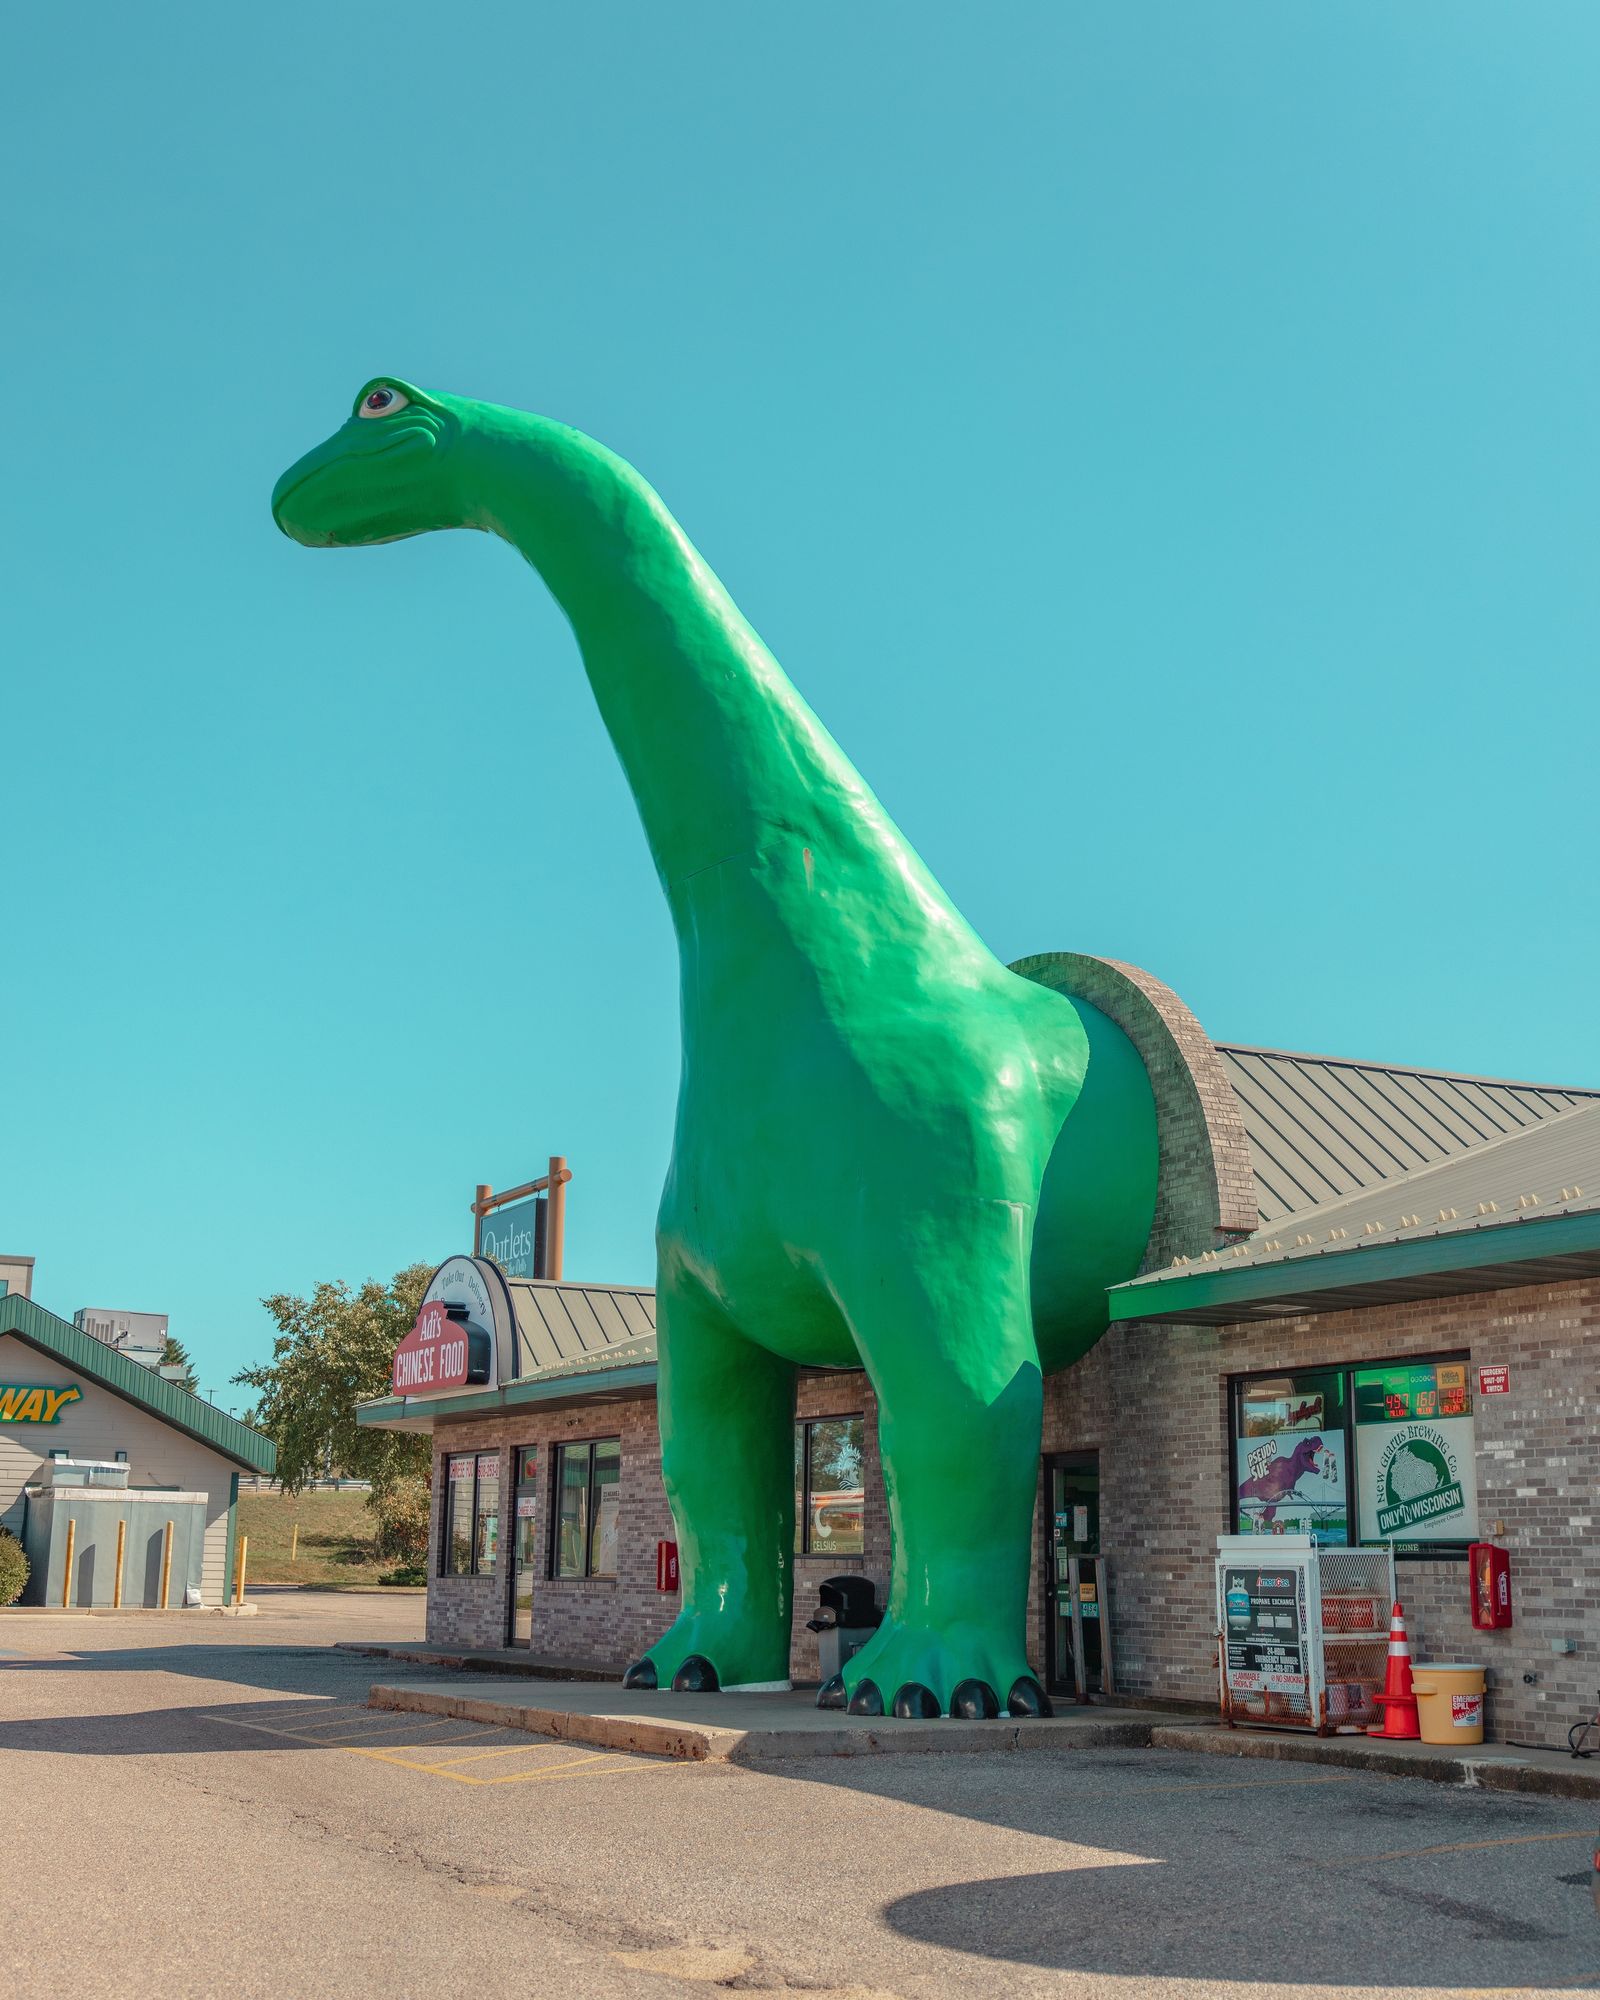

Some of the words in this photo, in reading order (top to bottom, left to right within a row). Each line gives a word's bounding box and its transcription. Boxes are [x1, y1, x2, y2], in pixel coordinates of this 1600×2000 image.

[484, 1222, 531, 1262] Outlets
[441, 1272, 454, 1290] Take
[455, 1270, 465, 1283] Out
[468, 1276, 487, 1316] Delivery
[420, 1309, 441, 1341] Adi's
[396, 1347, 434, 1387] CHINESE
[439, 1340, 465, 1379] FOOD
[1480, 1368, 1507, 1376] EMERGENCY
[1484, 1376, 1505, 1384] SHUT-OFF
[1385, 1393, 1409, 1409] 497
[1416, 1391, 1436, 1407] 160
[1247, 1440, 1277, 1466] PSEUDO
[1250, 1462, 1270, 1481] SUE
[1380, 1508, 1402, 1529] ONLY
[1410, 1488, 1461, 1519] WISCONSIN
[1424, 1517, 1447, 1529] Employee
[1446, 1511, 1464, 1521] Owned
[813, 1541, 837, 1551] CELSIUS
[1397, 1543, 1419, 1551] ZONE
[1256, 1577, 1291, 1587] AmeriGas
[1272, 1598, 1295, 1606] EXCHANGE
[1255, 1655, 1279, 1663] EMERGENCY
[1266, 1647, 1286, 1656] 24-HOUR
[1233, 1672, 1260, 1681] FLAMMABLE
[1283, 1675, 1304, 1684] SMOKING
